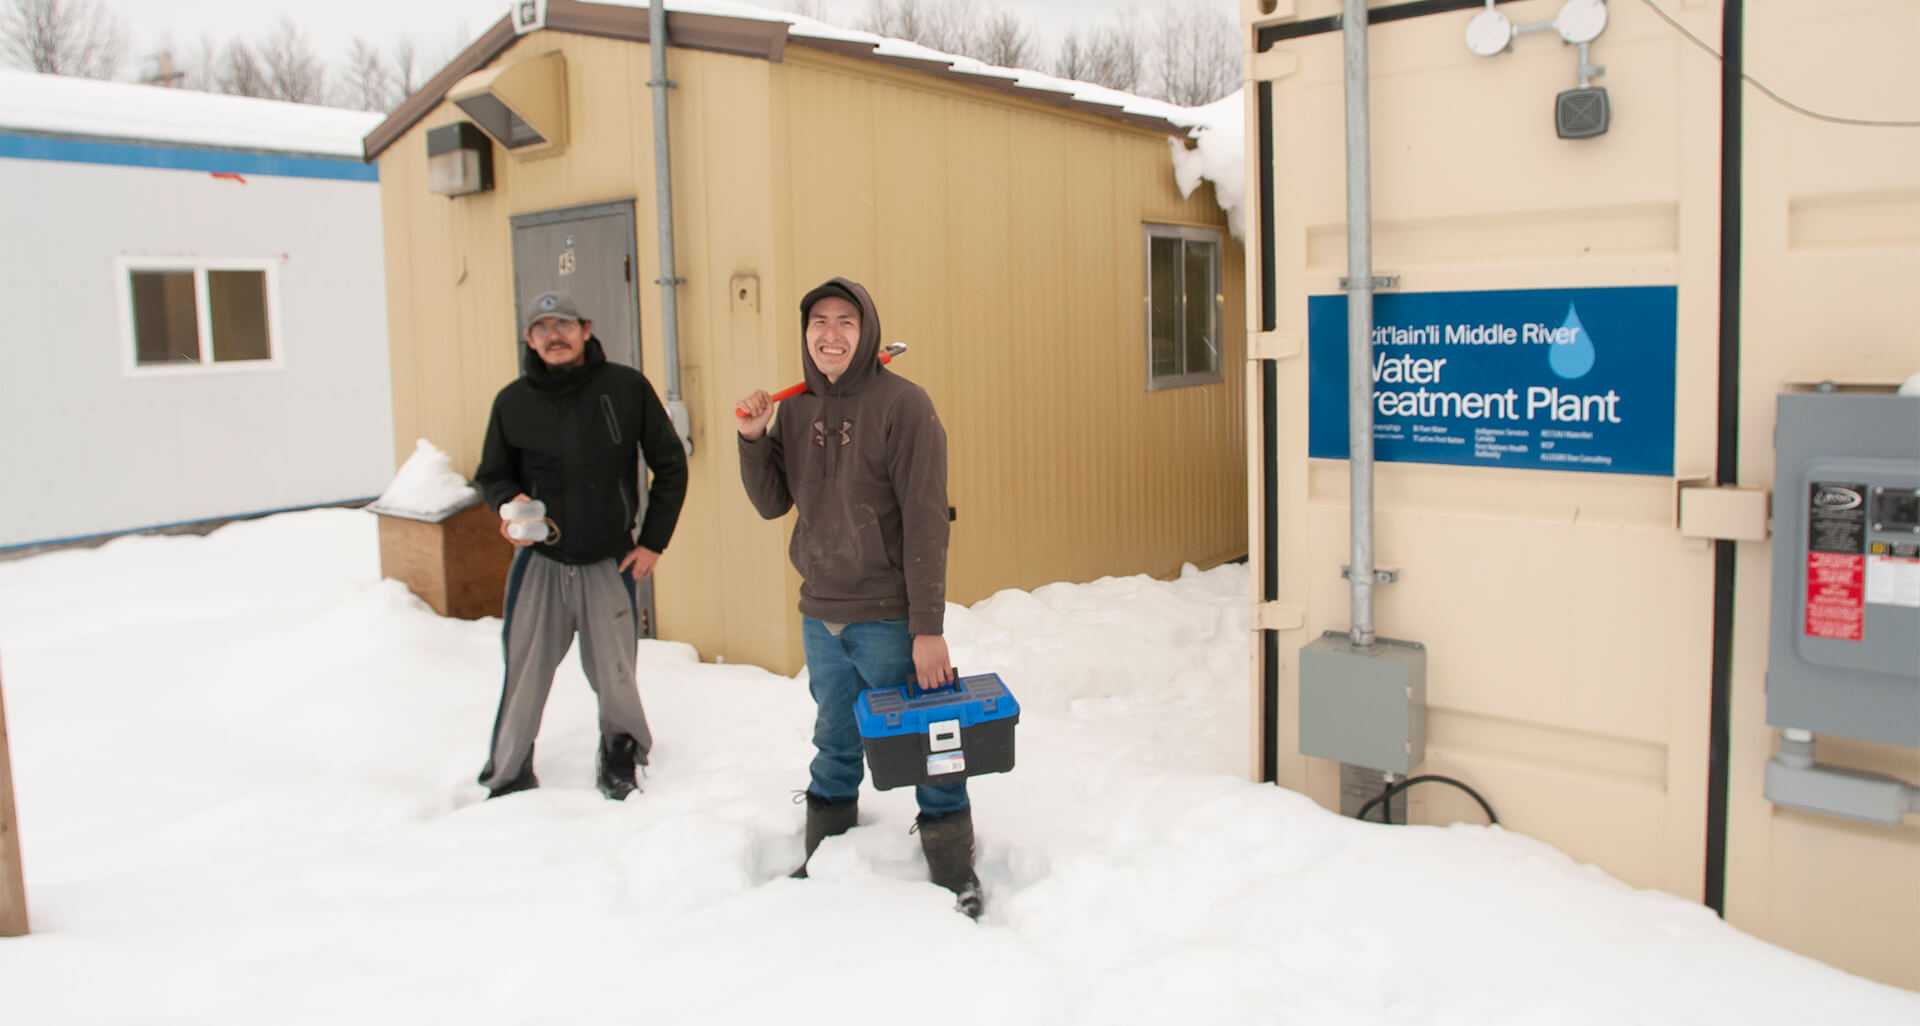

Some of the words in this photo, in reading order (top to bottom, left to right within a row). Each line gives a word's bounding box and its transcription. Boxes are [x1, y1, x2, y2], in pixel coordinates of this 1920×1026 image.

[1372, 325, 1440, 346] zit'lain'li
[1445, 323, 1517, 345] Middle
[1523, 322, 1581, 345] River
[1372, 387, 1520, 421] eatment
[1527, 386, 1622, 424] Plant
